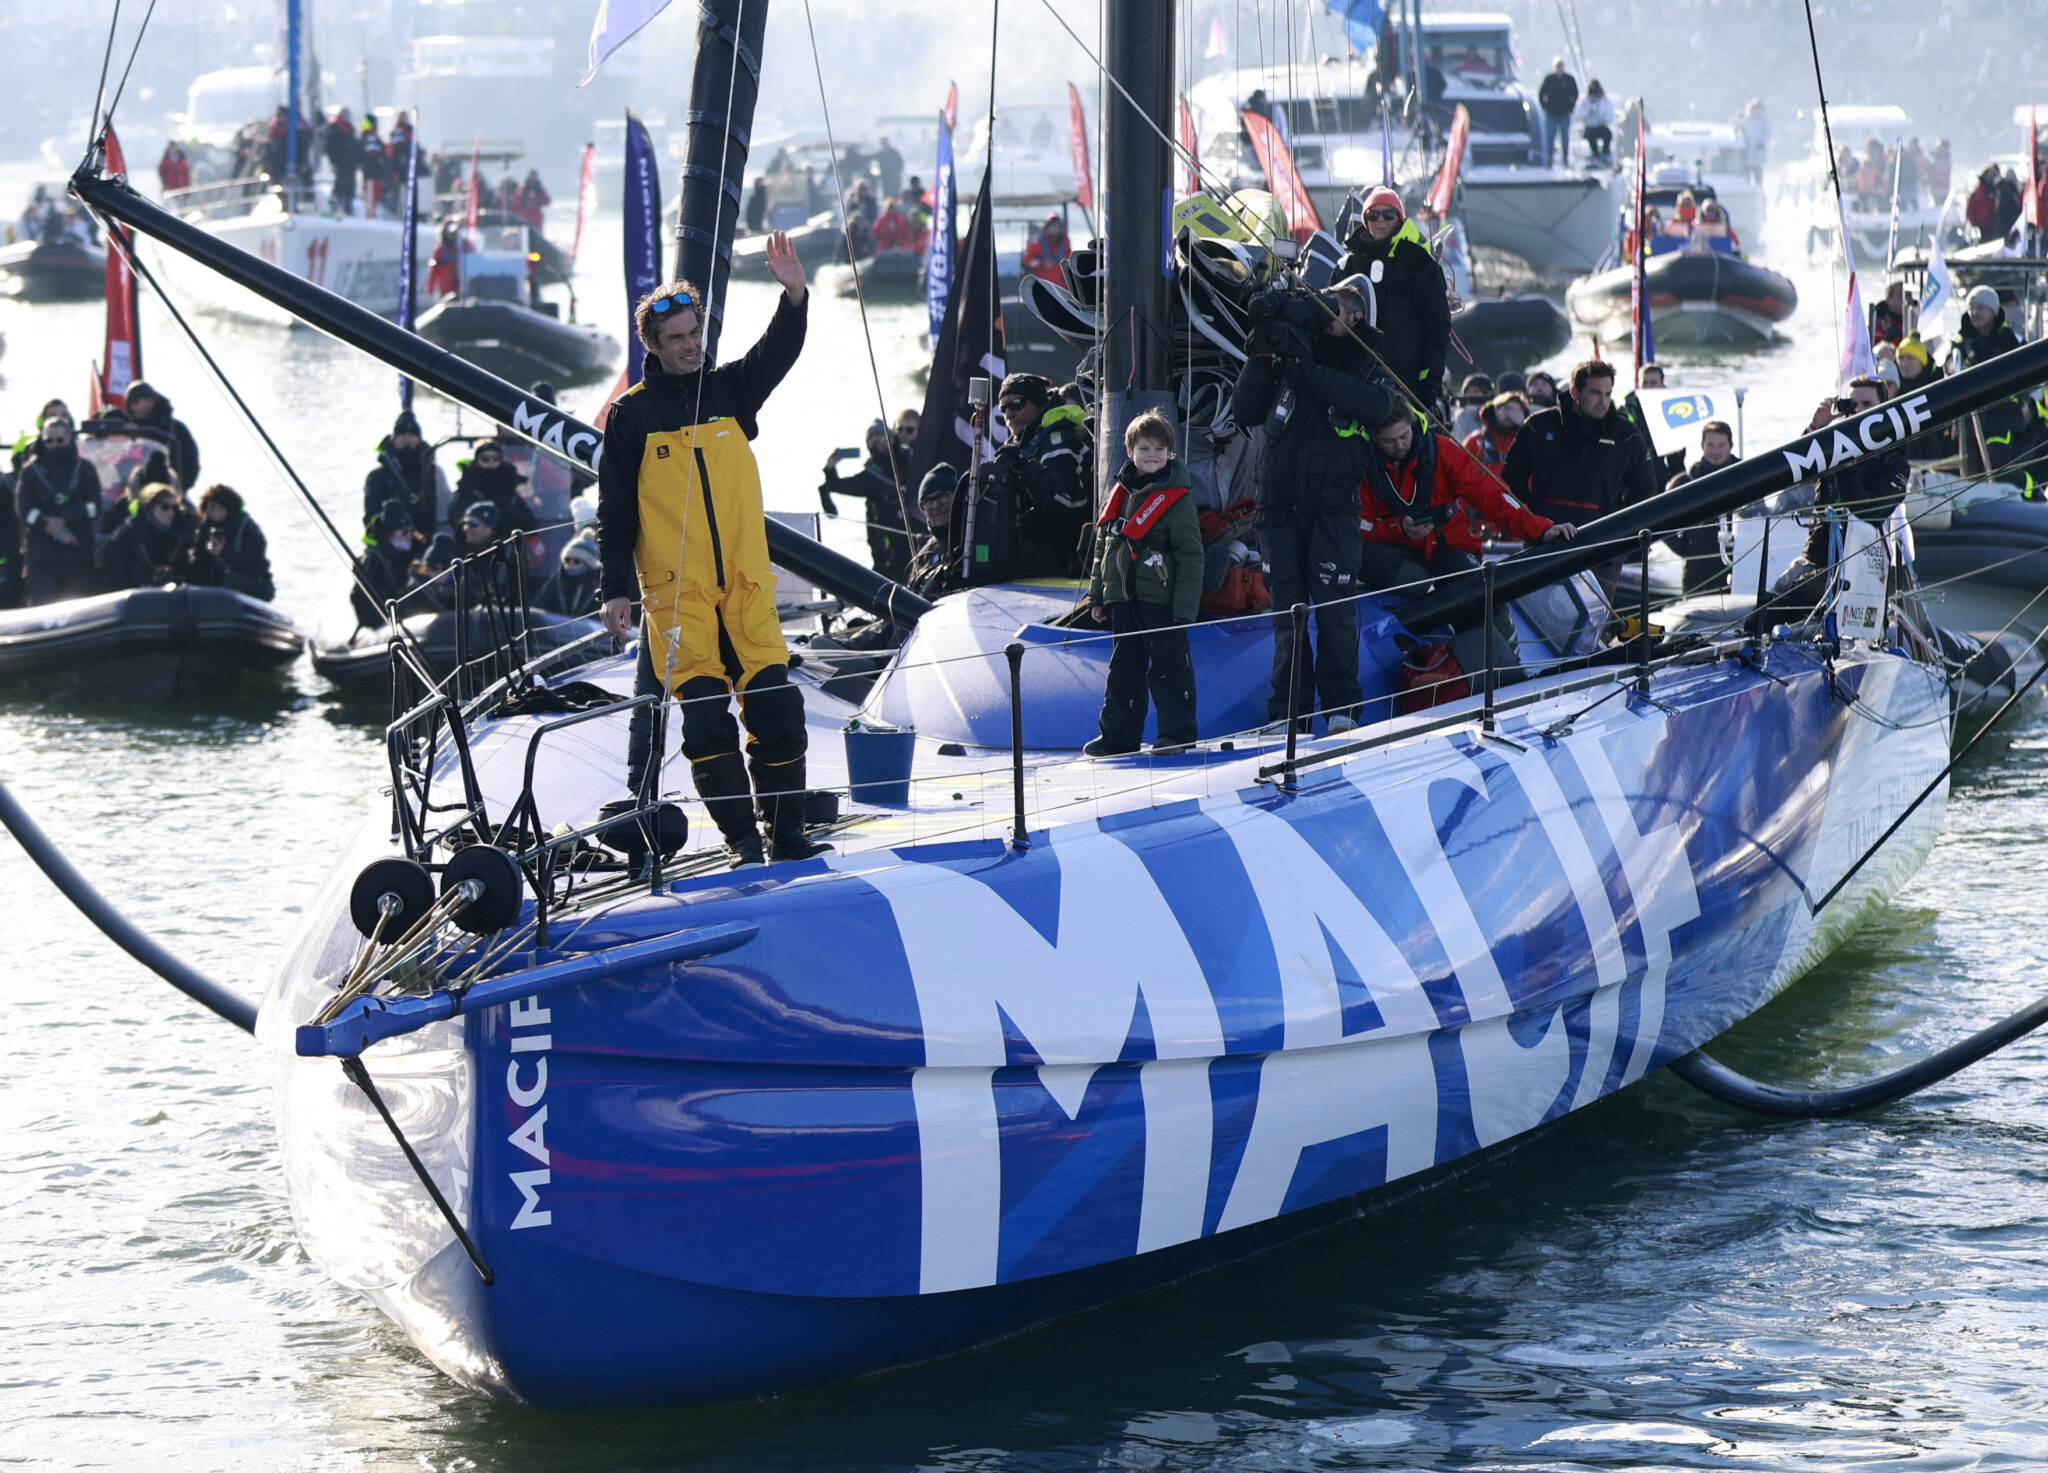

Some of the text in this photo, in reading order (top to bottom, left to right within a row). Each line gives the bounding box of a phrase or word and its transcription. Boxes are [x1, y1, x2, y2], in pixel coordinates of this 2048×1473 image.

[1782, 394, 1932, 484] MACIF
[506, 994, 553, 1230] MACIF
[826, 708, 1701, 1295] MACIF
